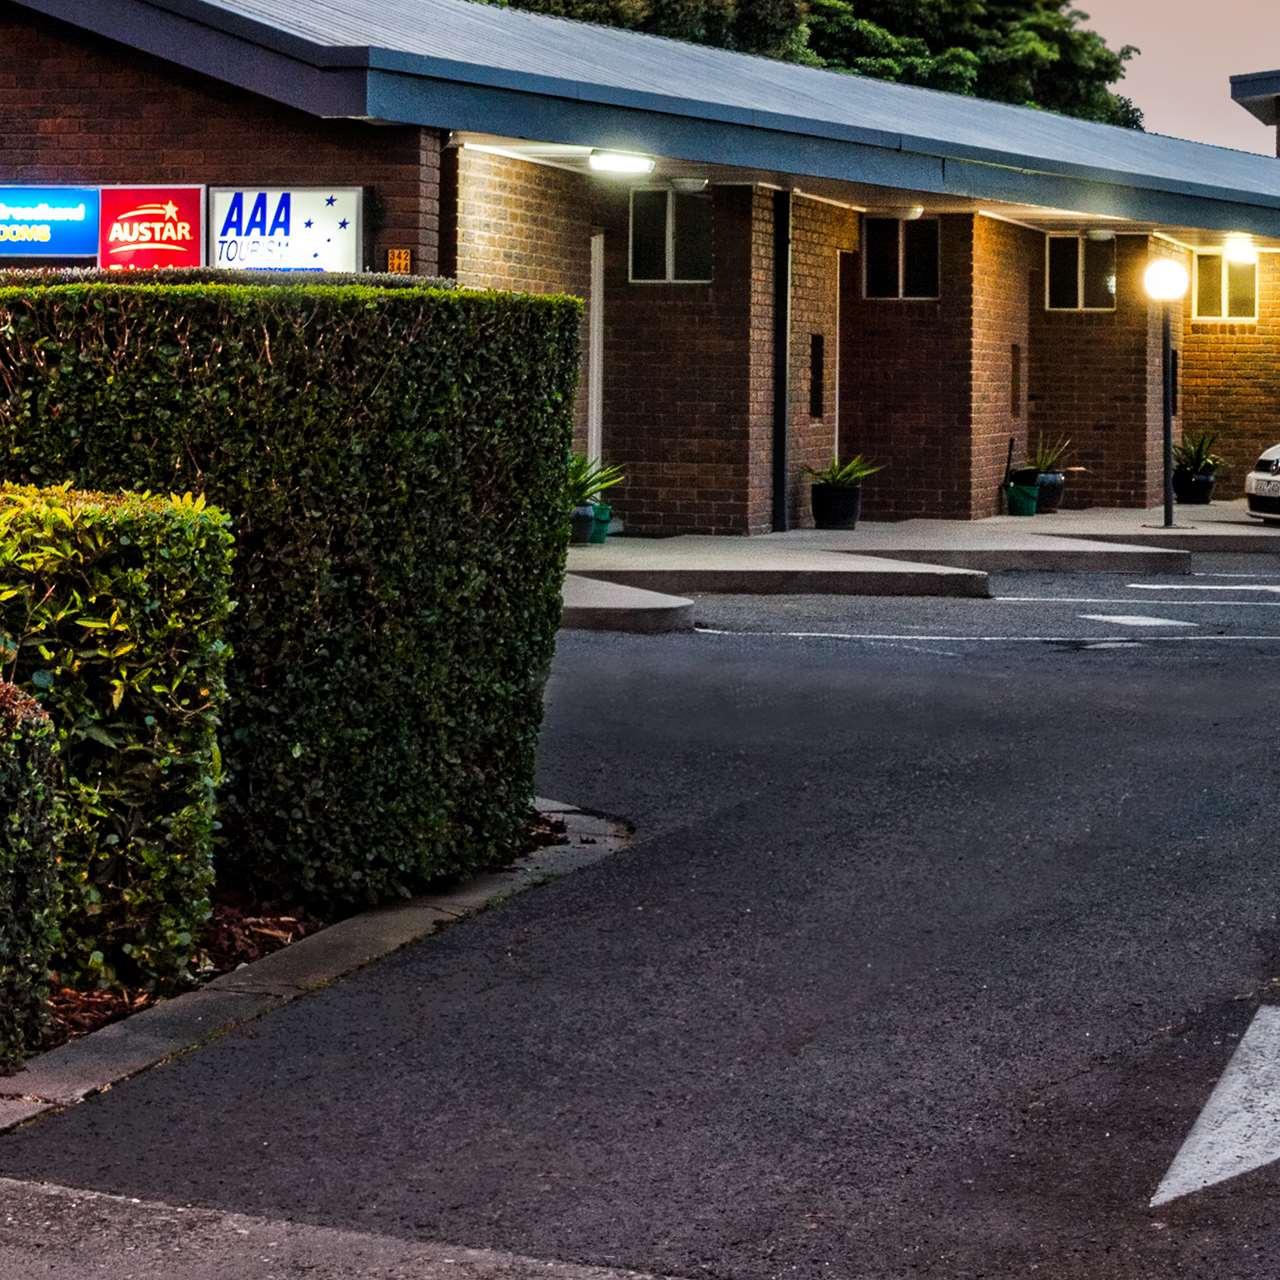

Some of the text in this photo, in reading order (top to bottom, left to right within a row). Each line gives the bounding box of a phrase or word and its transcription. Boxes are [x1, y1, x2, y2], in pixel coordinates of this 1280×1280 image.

[220, 192, 291, 236] AAA
[108, 221, 192, 242] AUSTAR
[218, 239, 289, 262] TOURS
